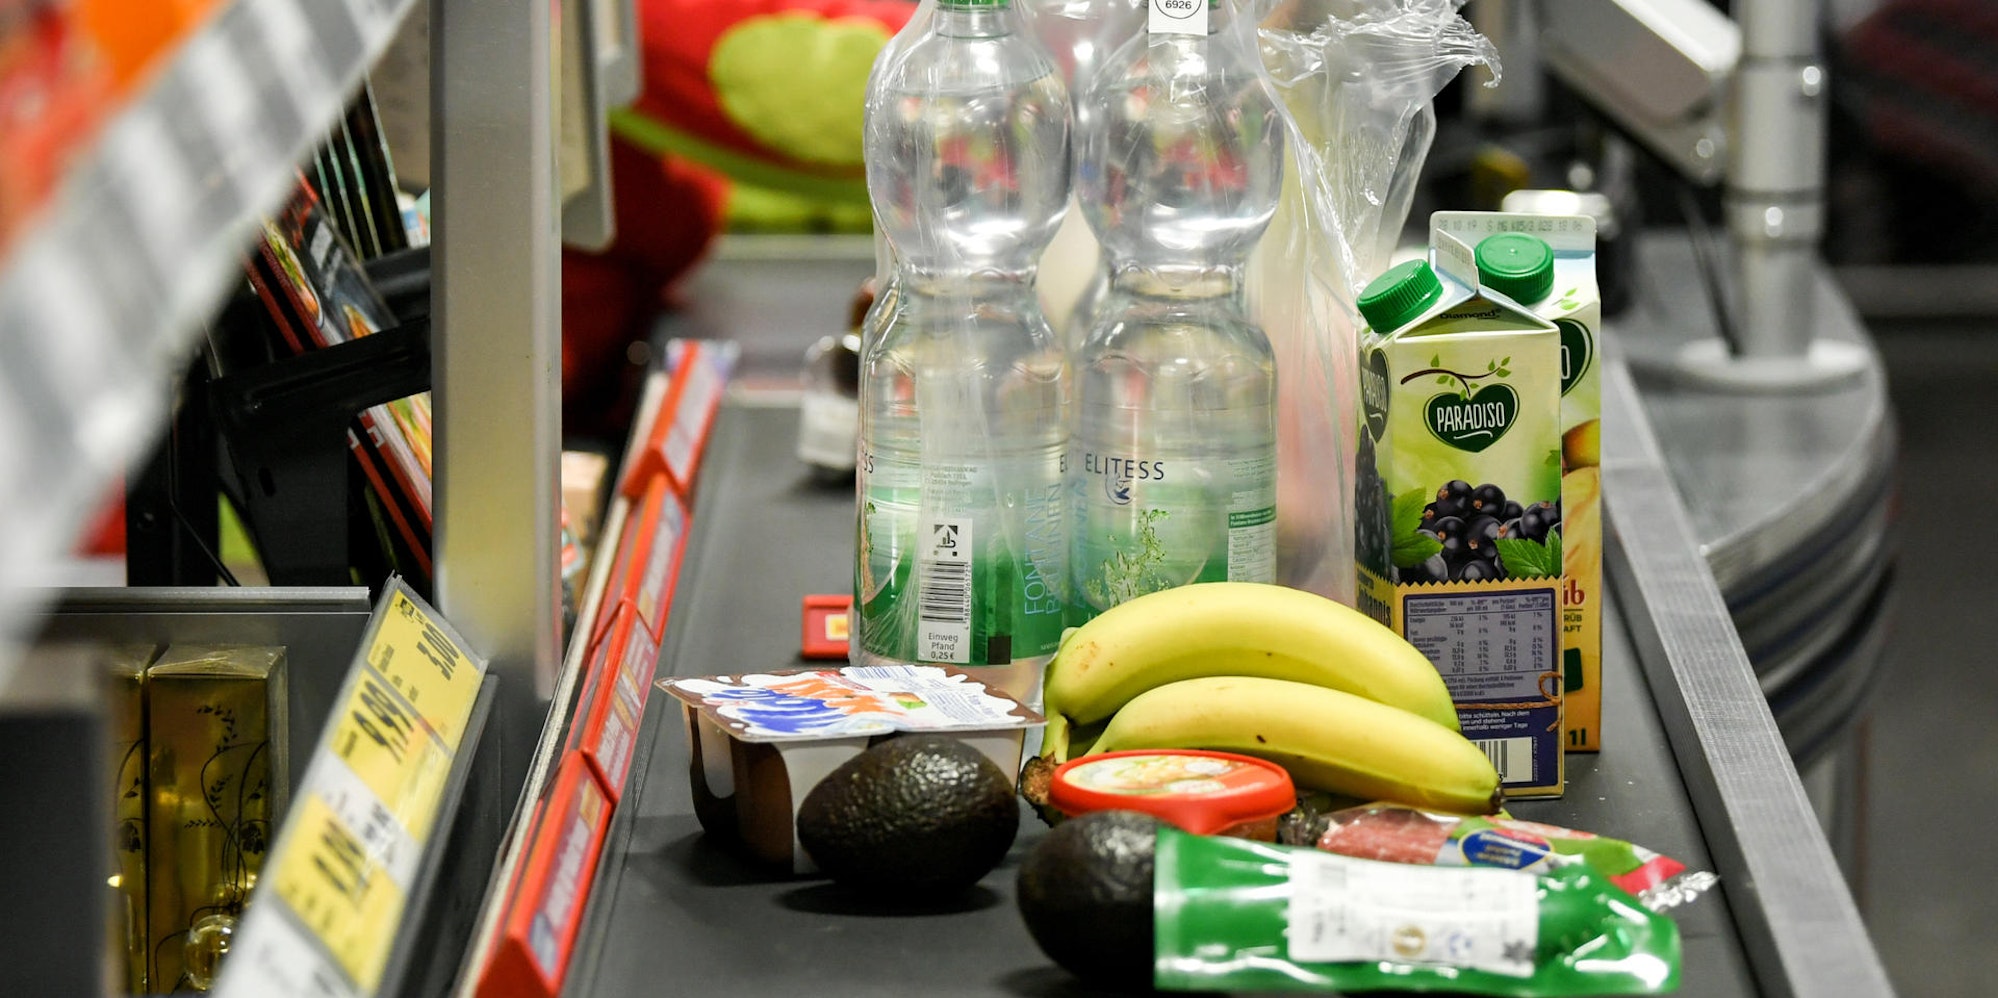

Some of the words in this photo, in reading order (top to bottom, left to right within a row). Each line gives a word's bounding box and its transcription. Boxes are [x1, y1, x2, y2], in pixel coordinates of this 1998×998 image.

[1165, 0, 1192, 9] 6926
[1436, 401, 1506, 433] PARADISO
[1085, 453, 1165, 480] ELITESS
[928, 632, 958, 643] Einweg
[416, 622, 459, 681] 3,00
[931, 642, 955, 651] Pfand
[931, 651, 948, 660] 0,25
